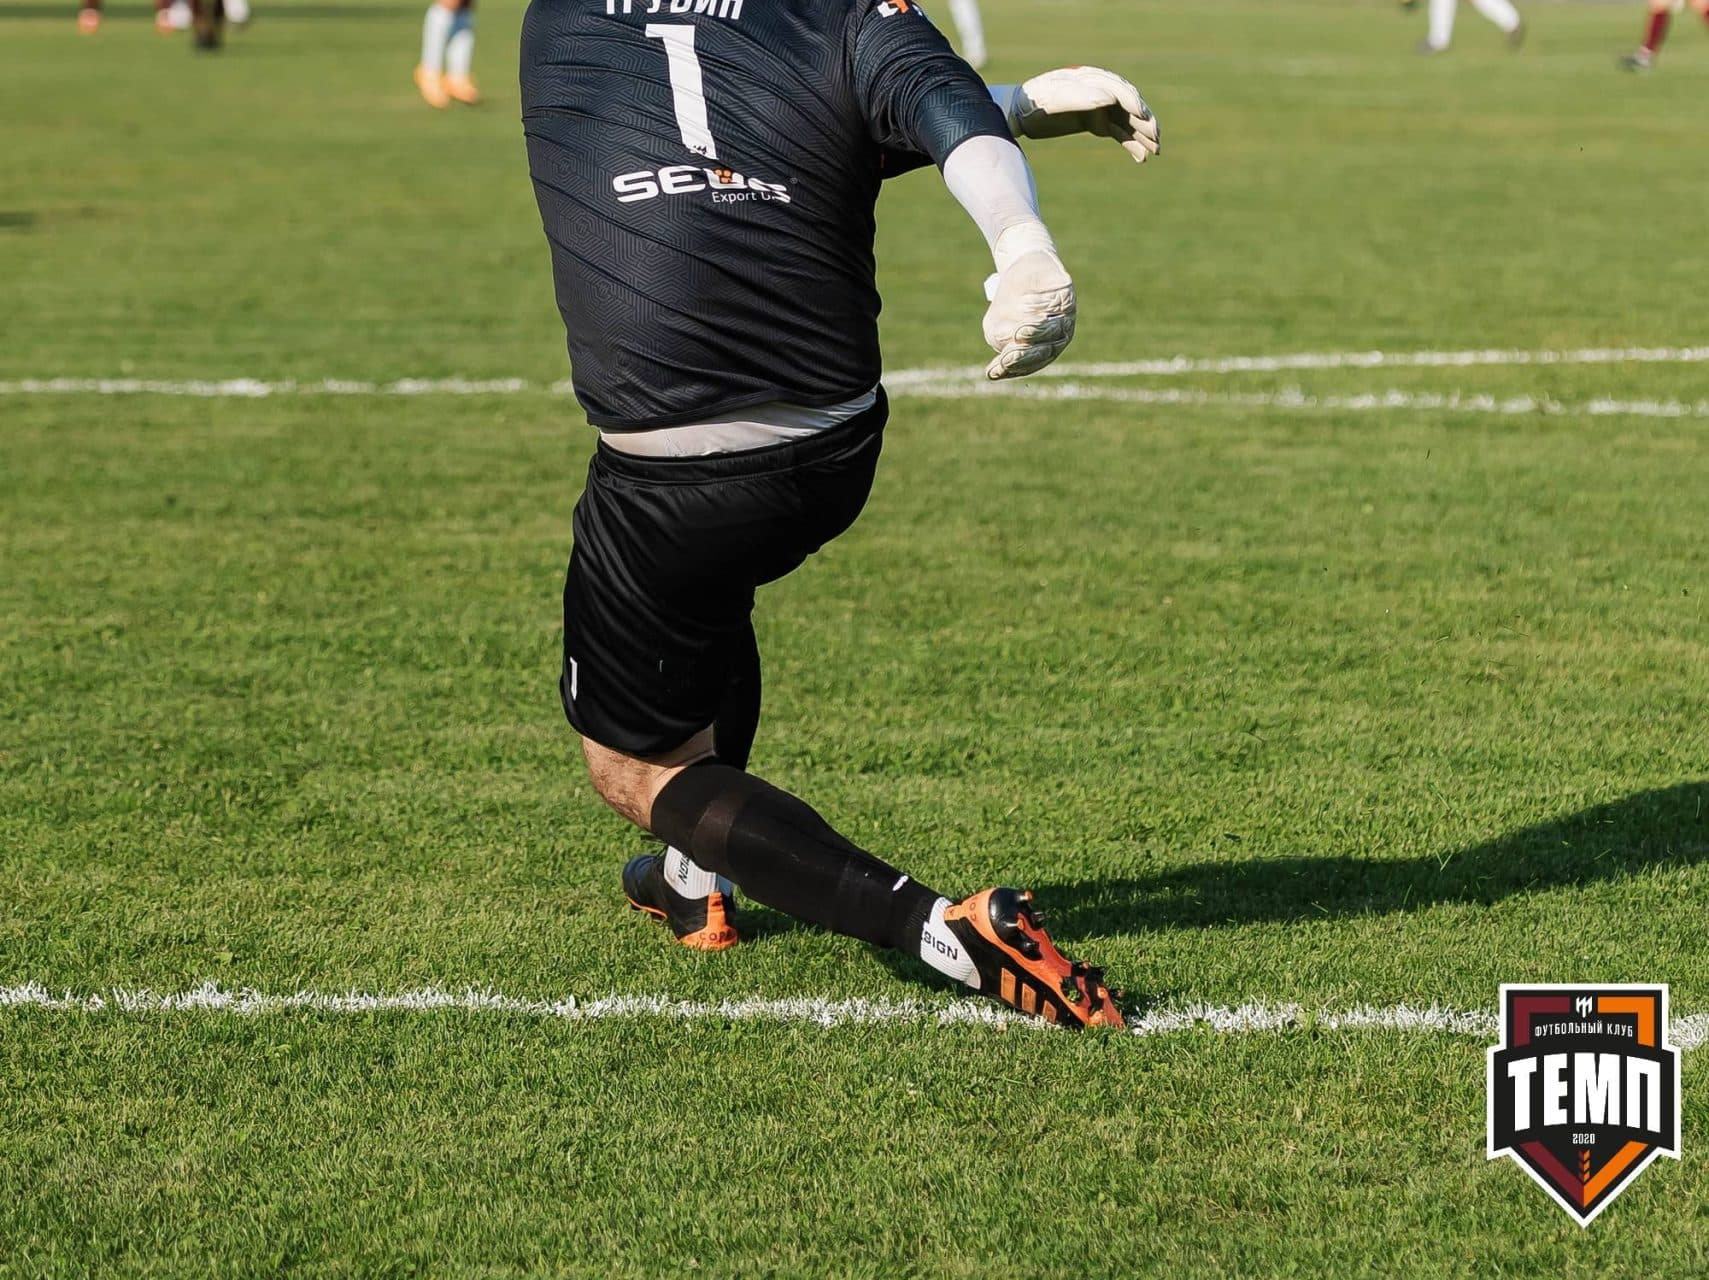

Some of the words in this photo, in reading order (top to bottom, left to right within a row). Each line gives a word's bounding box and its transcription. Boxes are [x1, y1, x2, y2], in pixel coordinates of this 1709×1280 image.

[645, 23, 718, 160] 1
[712, 191, 757, 204] Export
[921, 929, 959, 961] SIGN
